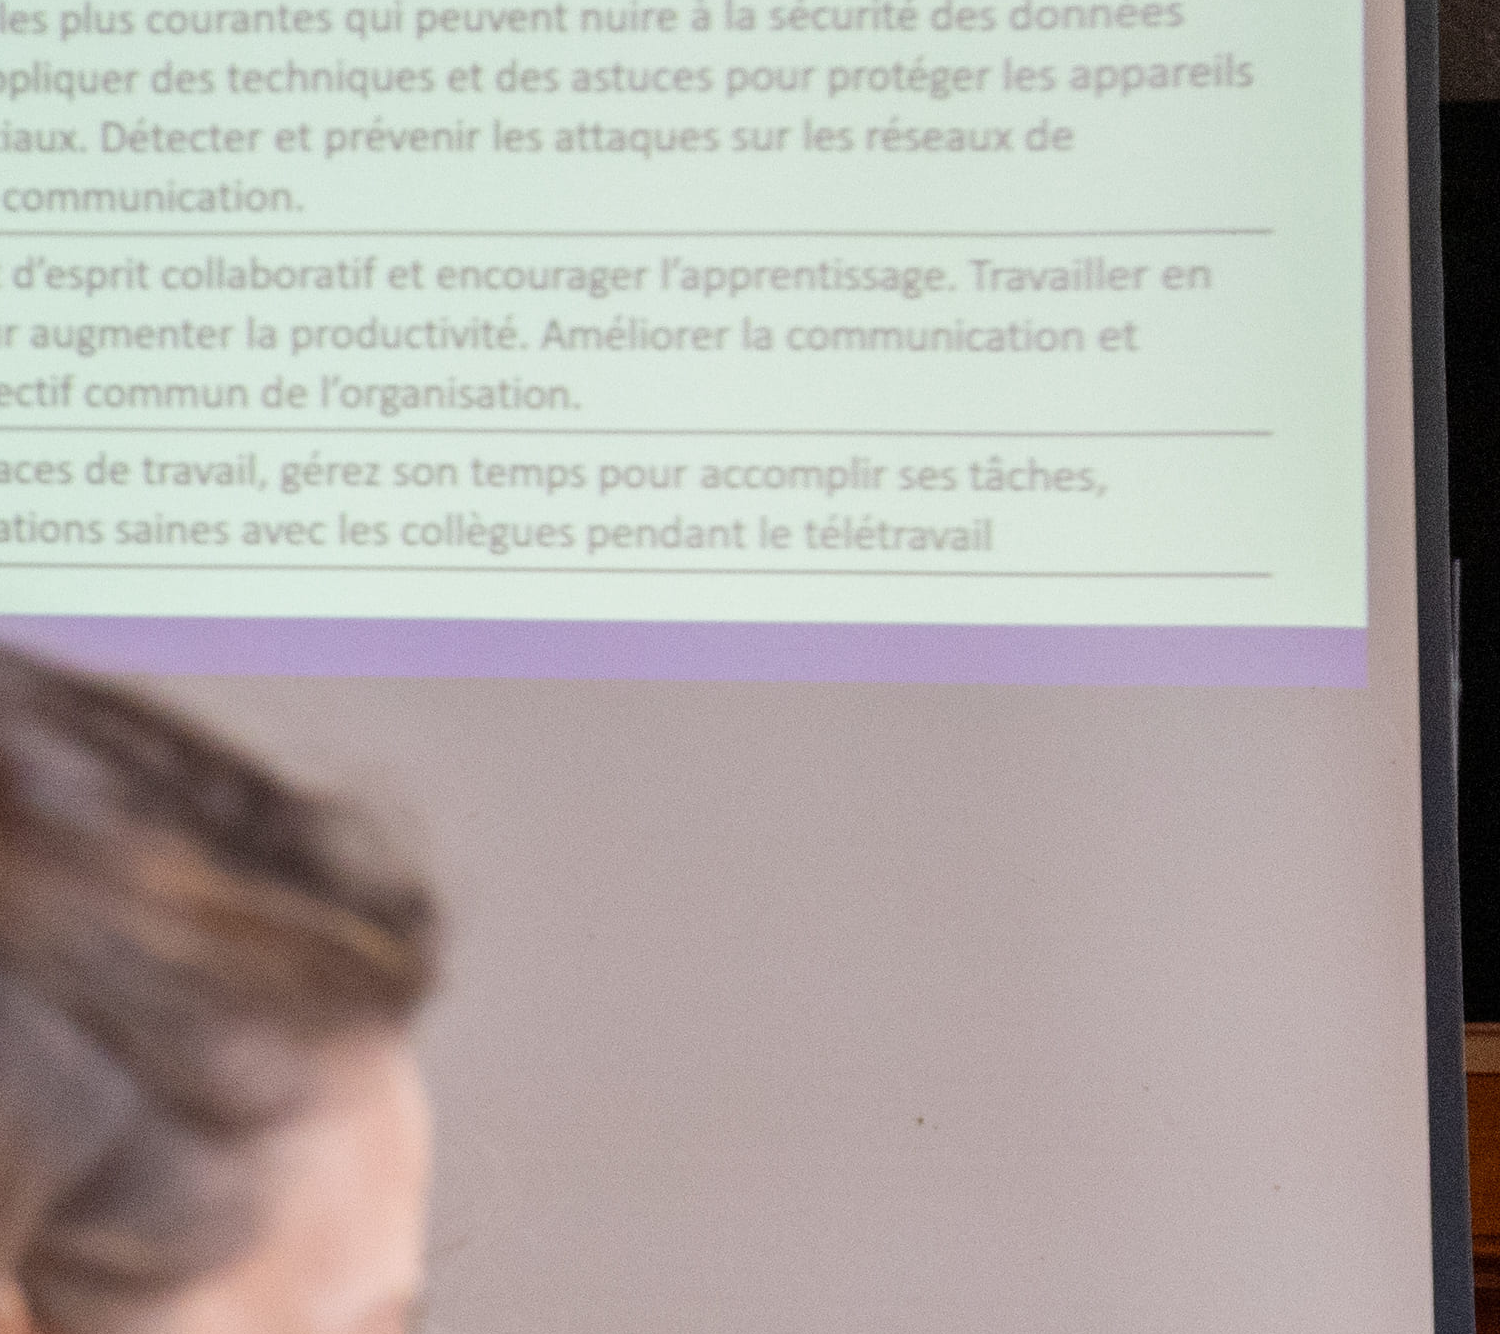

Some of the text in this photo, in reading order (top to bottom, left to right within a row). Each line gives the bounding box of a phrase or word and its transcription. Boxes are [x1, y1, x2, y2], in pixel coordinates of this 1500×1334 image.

[57, 0, 137, 43] plus
[143, 3, 335, 37] courantes
[342, 0, 405, 42] qui
[413, 1, 570, 41] peuvent
[578, 0, 680, 35] nuire
[148, 59, 217, 97] des
[224, 59, 438, 100] techniques
[444, 61, 485, 95] et
[492, 58, 562, 95] des
[569, 61, 716, 95] astuces
[724, 64, 818, 100] pour
[825, 55, 993, 102] protéger
[1001, 56, 1059, 94] les
[1067, 52, 1256, 98] appareils
[98, 117, 264, 156] Détecter
[272, 122, 313, 155] et
[322, 115, 482, 160] prévenir
[491, 117, 545, 155] les
[552, 121, 722, 160] attaques
[730, 125, 792, 154] sur
[801, 117, 856, 154] les
[864, 115, 1014, 154] réseaux
[1023, 117, 1076, 154] de
[0, 180, 305, 215] communication.
[158, 254, 378, 293] collaboratif
[385, 258, 426, 292] et
[433, 264, 650, 301] encourager
[659, 256, 957, 302] l’apprentissage.
[968, 256, 1150, 294] Travailler
[1159, 263, 1213, 292] en
[28, 319, 235, 360] augmenter
[244, 314, 280, 352] la
[288, 314, 529, 357] productivité.
[538, 314, 732, 353] Améliorer
[740, 316, 776, 353] la
[784, 319, 1087, 355] communication
[1095, 320, 1140, 354] et
[81, 381, 251, 411] commun
[258, 374, 310, 411] de
[319, 374, 582, 419] l’organisation.
[82, 450, 133, 488] de
[139, 451, 269, 492] travail,
[278, 450, 383, 497] gérez
[391, 460, 460, 489] son
[468, 456, 589, 497] temps
[596, 462, 689, 497] pour
[698, 455, 888, 497] accomplir
[897, 464, 960, 493] ses
[966, 454, 1108, 497] tâches,
[113, 512, 232, 548] saines
[239, 519, 327, 548] avec
[336, 511, 392, 548] les
[398, 511, 577, 558] collègues
[585, 514, 747, 556] pendant
[758, 515, 794, 552] le
[802, 513, 994, 554] télétravail
